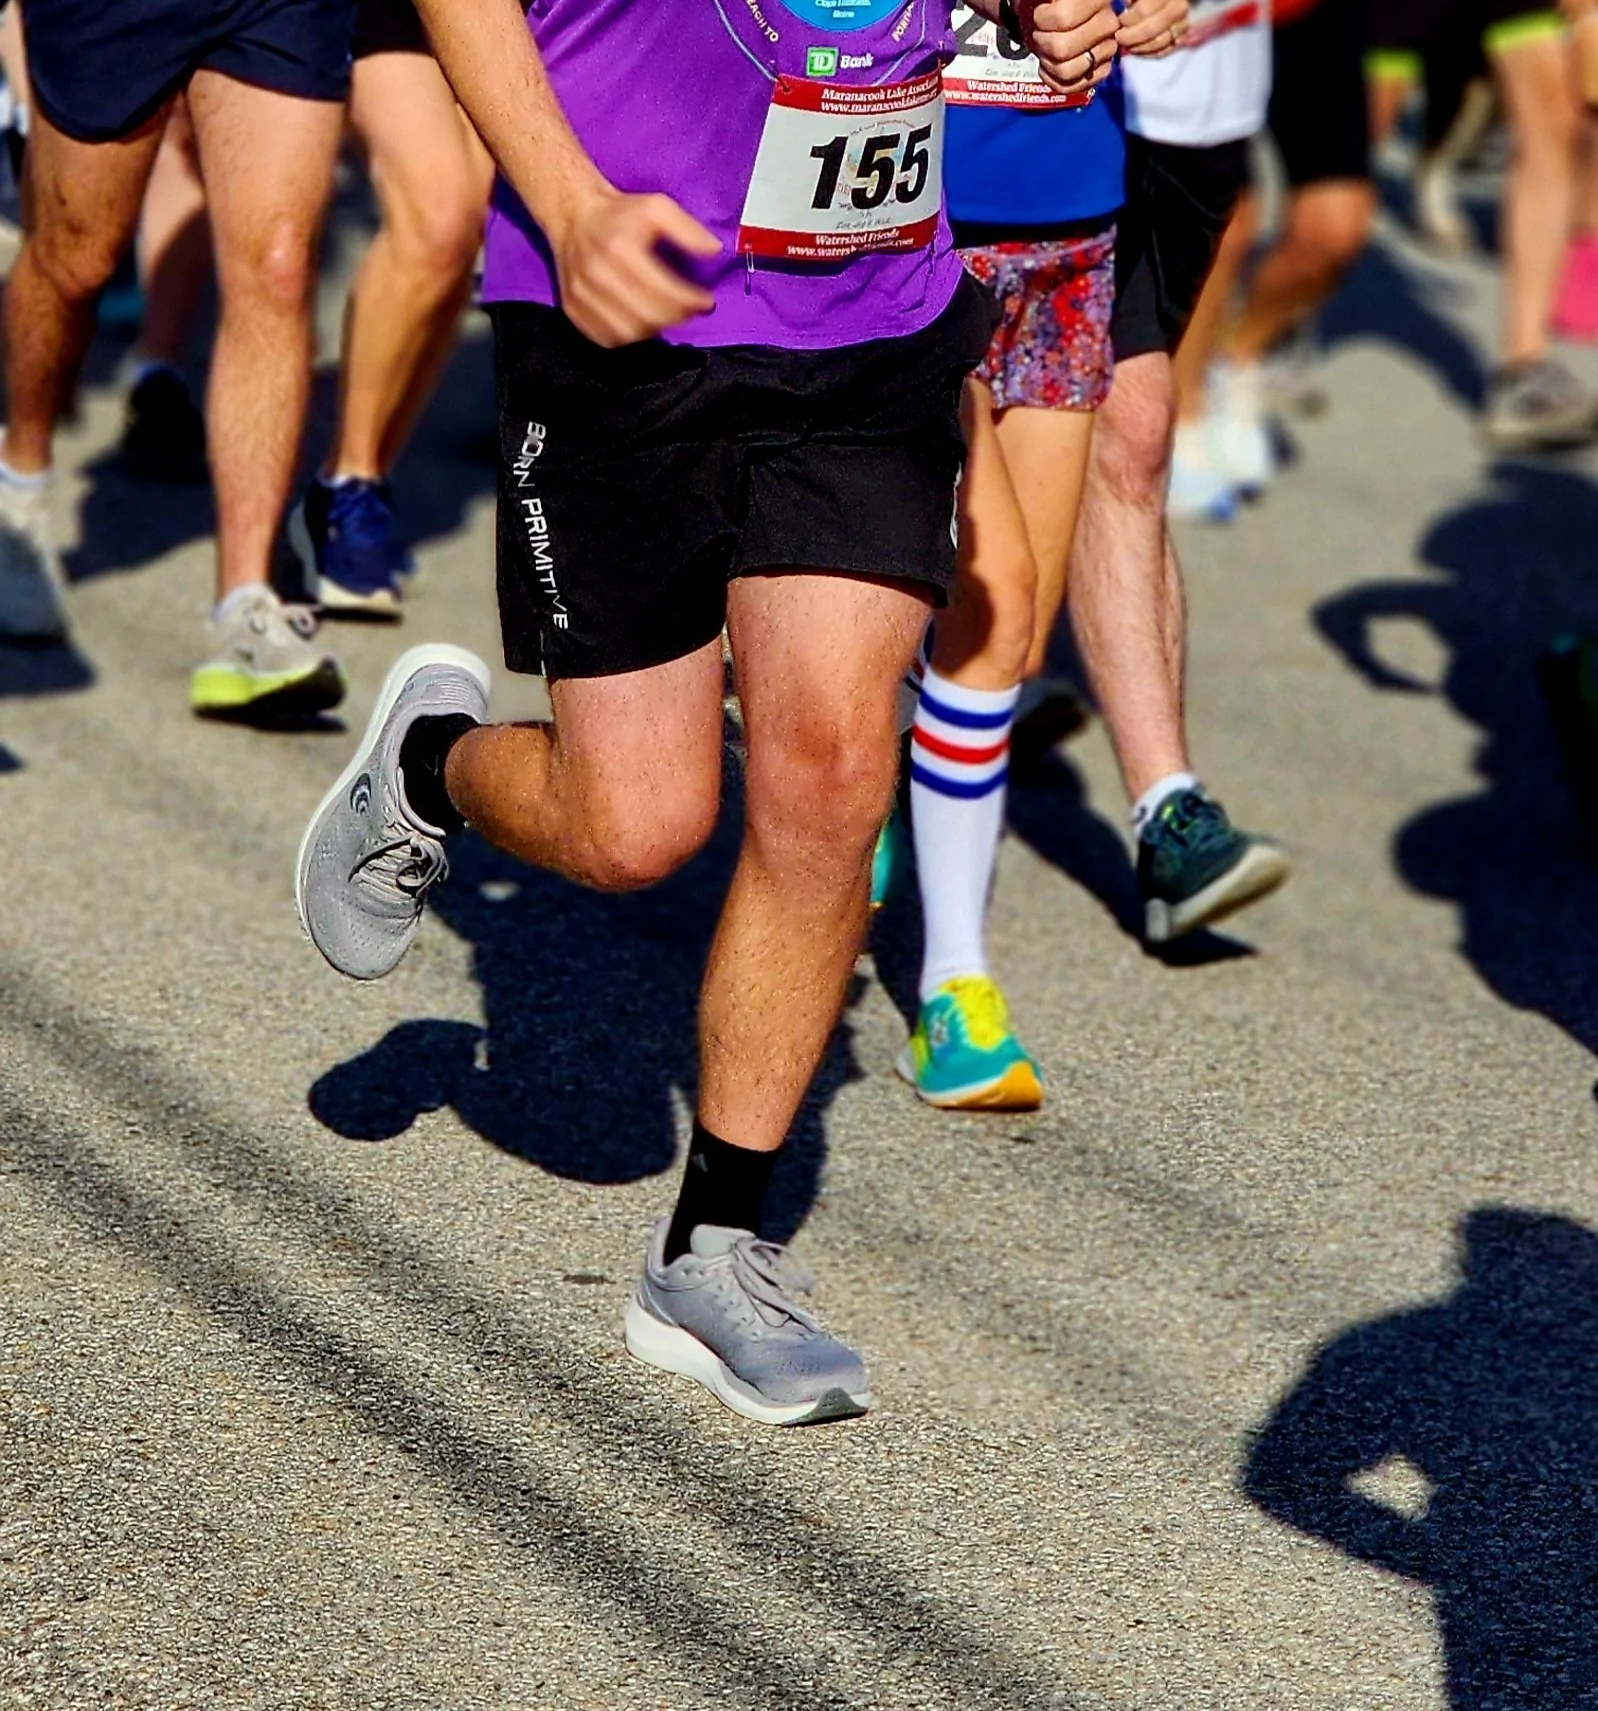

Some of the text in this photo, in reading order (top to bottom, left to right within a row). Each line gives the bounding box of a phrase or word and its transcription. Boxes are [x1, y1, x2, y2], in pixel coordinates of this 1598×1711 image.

[764, 26, 779, 42] TO
[840, 53, 874, 69] Bank
[967, 80, 1018, 93] Watershed
[809, 124, 933, 211] 155
[815, 227, 900, 246] Watershed Friends
[513, 420, 569, 630] BORN PRIMITIVE
